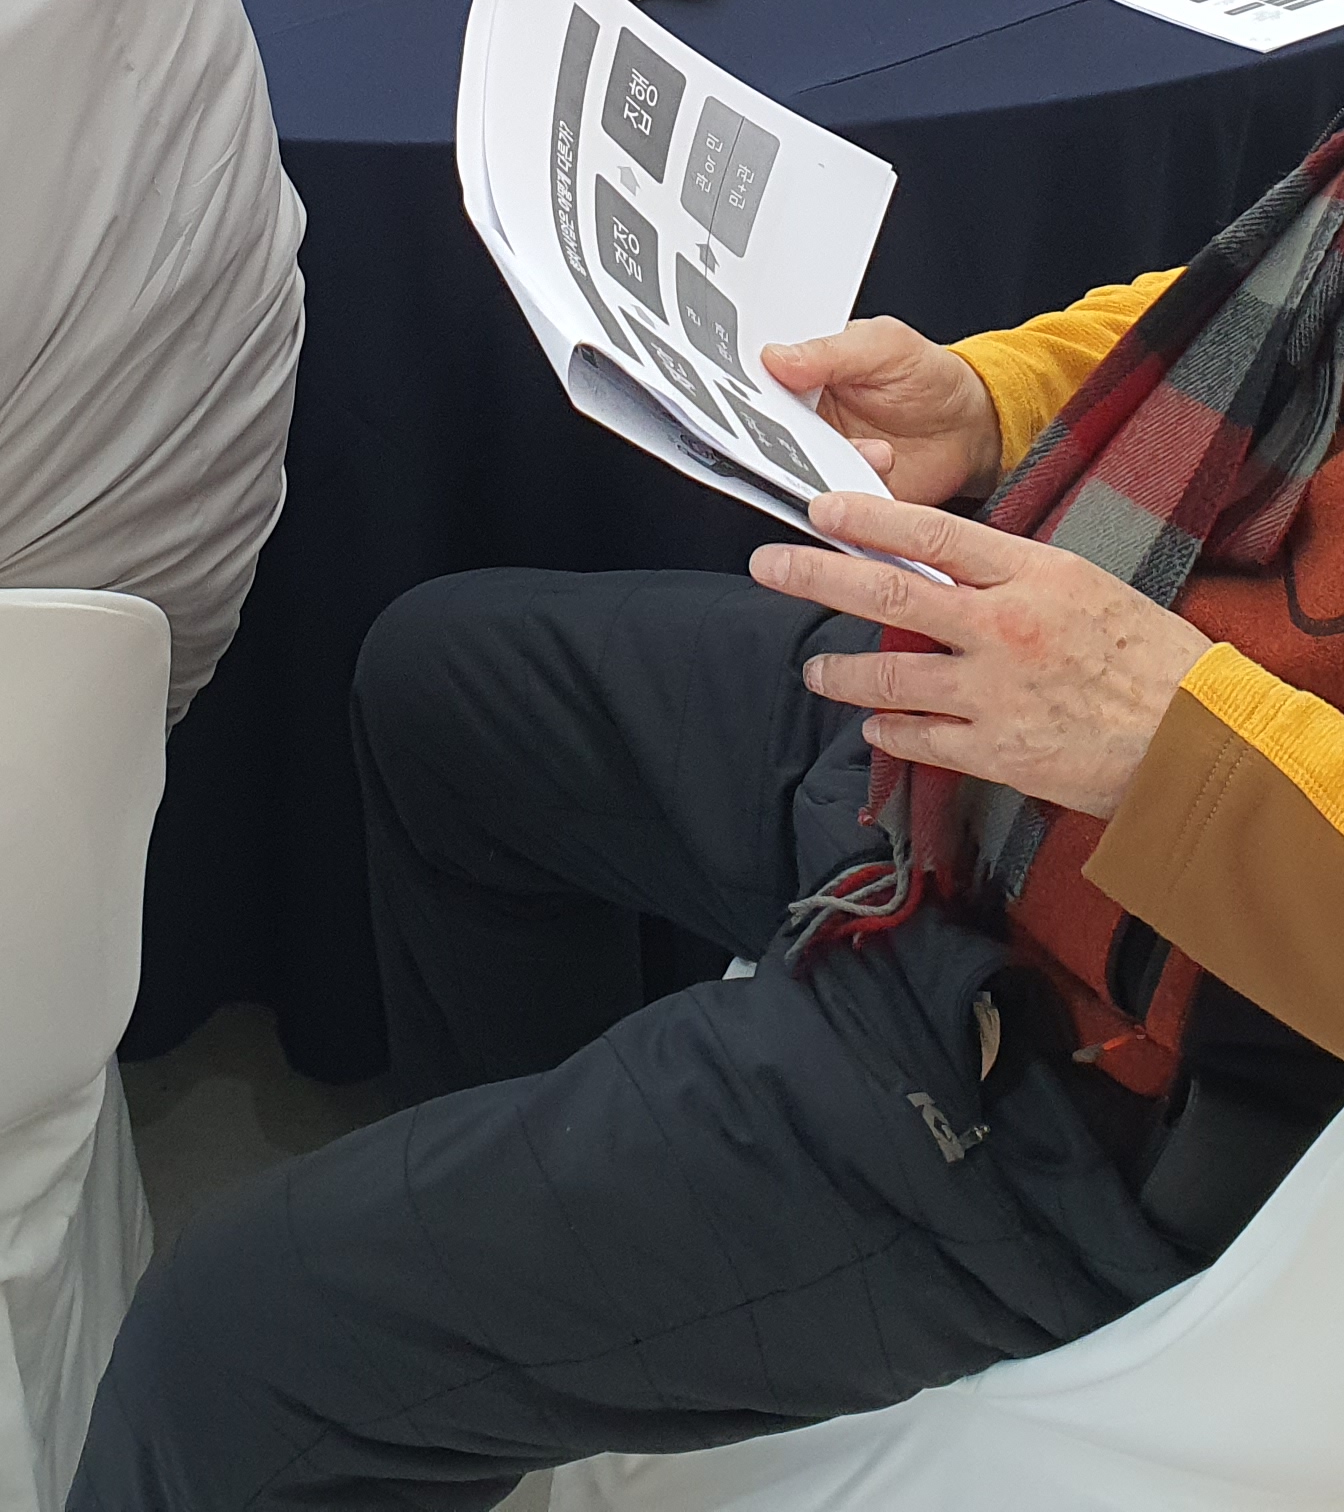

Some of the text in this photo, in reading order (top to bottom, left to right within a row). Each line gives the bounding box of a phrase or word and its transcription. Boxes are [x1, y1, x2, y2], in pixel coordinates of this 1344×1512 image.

[623, 68, 658, 136] 집행
[557, 120, 574, 173] 다른가?
[695, 133, 723, 193] 관 or 민
[556, 168, 573, 213] 어떻게
[729, 164, 755, 210] 민+관
[613, 217, 643, 283] 결정
